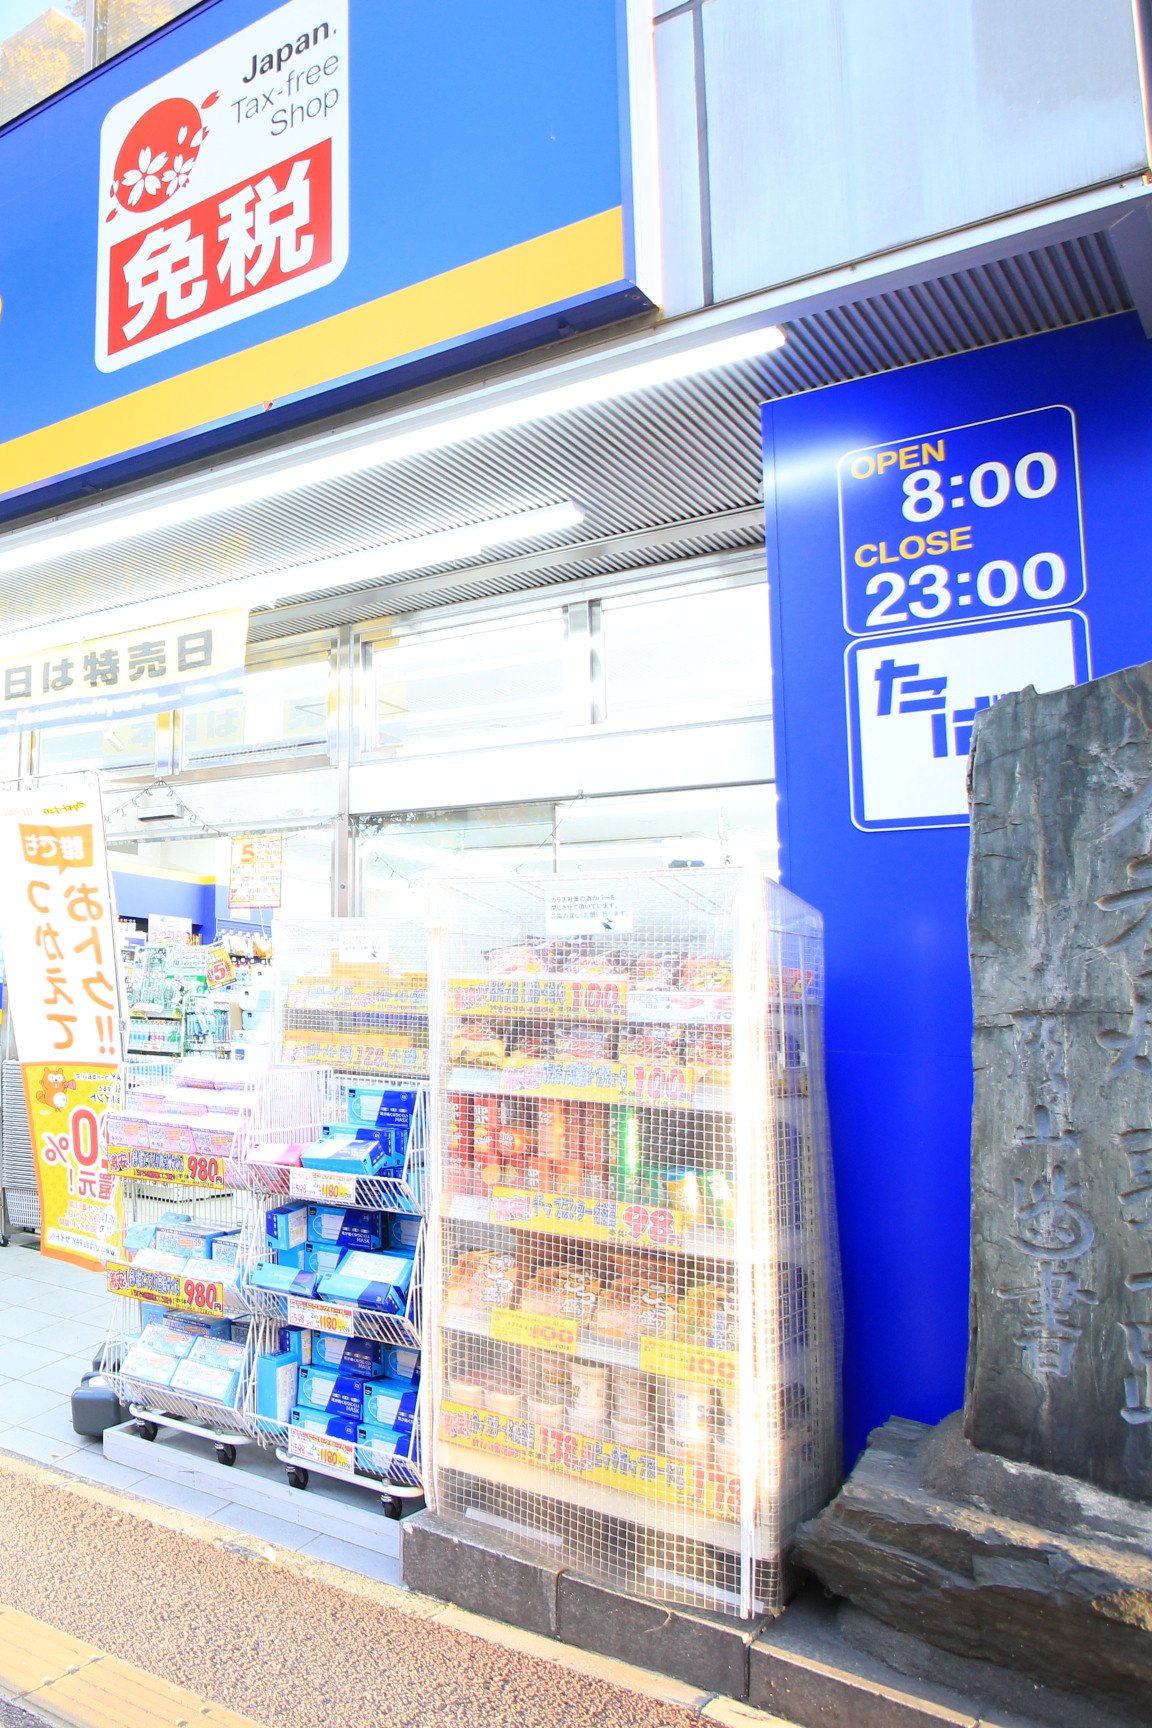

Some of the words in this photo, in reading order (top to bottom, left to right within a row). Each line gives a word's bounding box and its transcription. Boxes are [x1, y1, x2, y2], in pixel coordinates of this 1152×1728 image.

[242, 20, 337, 84] Japan.
[231, 55, 339, 124] Tax-free
[270, 87, 339, 136] Shop
[121, 159, 314, 341] 免税
[851, 439, 945, 480] OPEN
[901, 451, 1058, 523] 8:00
[854, 526, 973, 567] CLOSE
[865, 552, 1066, 627] 23:00
[321, 1183, 339, 1198] 1180
[183, 1279, 223, 1312] 980円
[320, 1314, 338, 1331] 1180
[320, 1447, 338, 1465] 1180
